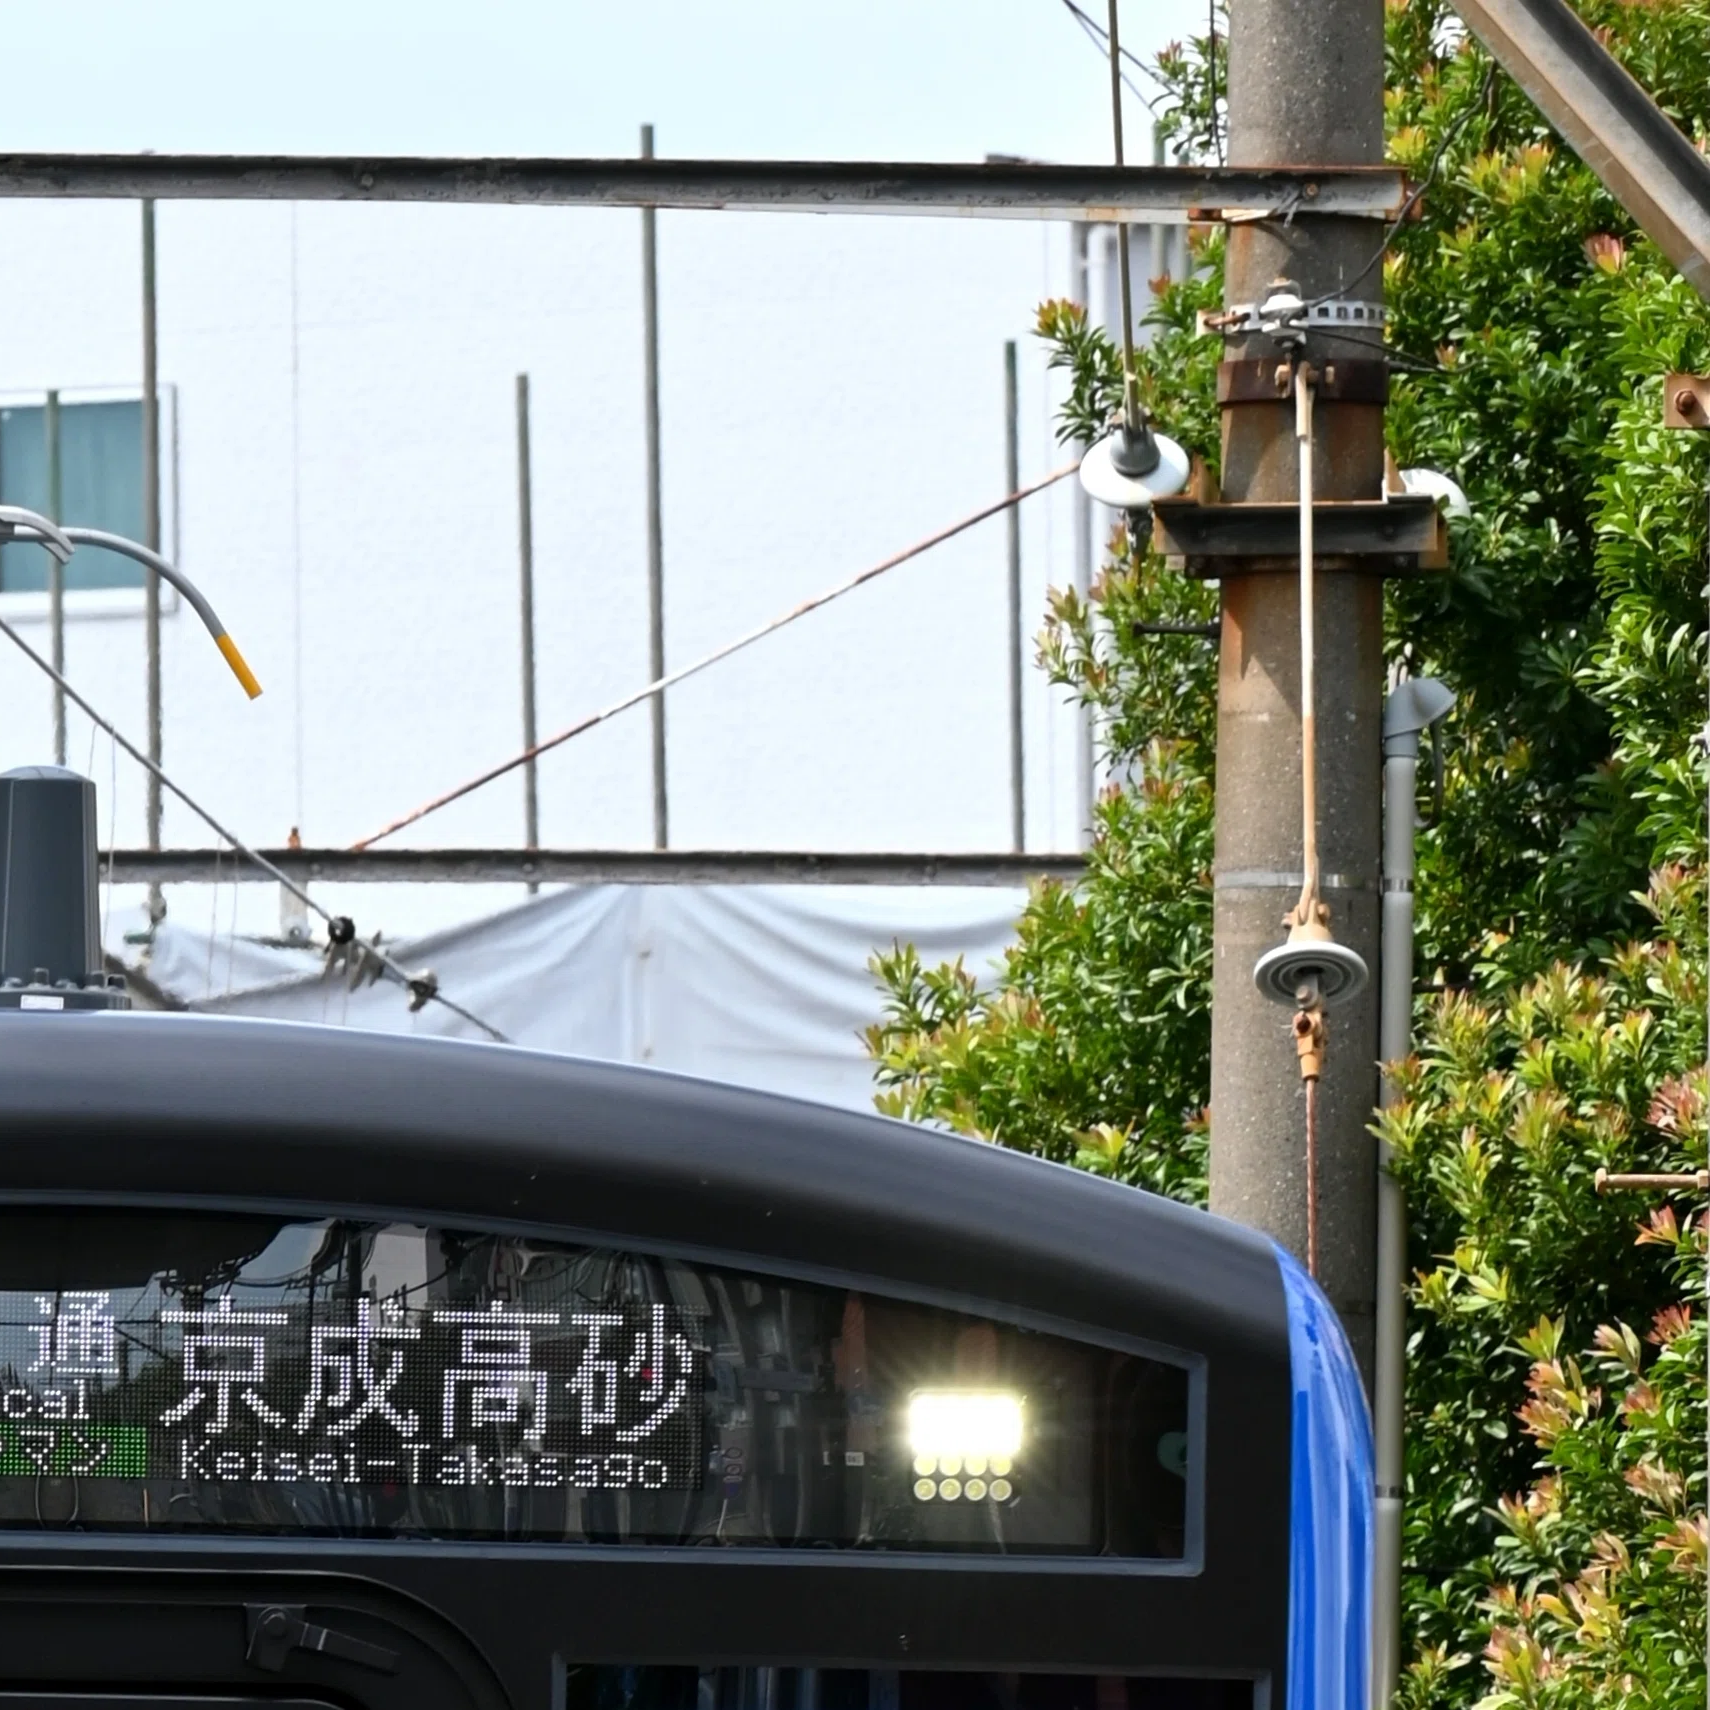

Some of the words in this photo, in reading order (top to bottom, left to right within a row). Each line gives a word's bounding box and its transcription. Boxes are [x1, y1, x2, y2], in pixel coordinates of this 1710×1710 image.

[159, 1294, 693, 1442] 京成高砂
[180, 1440, 669, 1489] Keisei-Takasago
